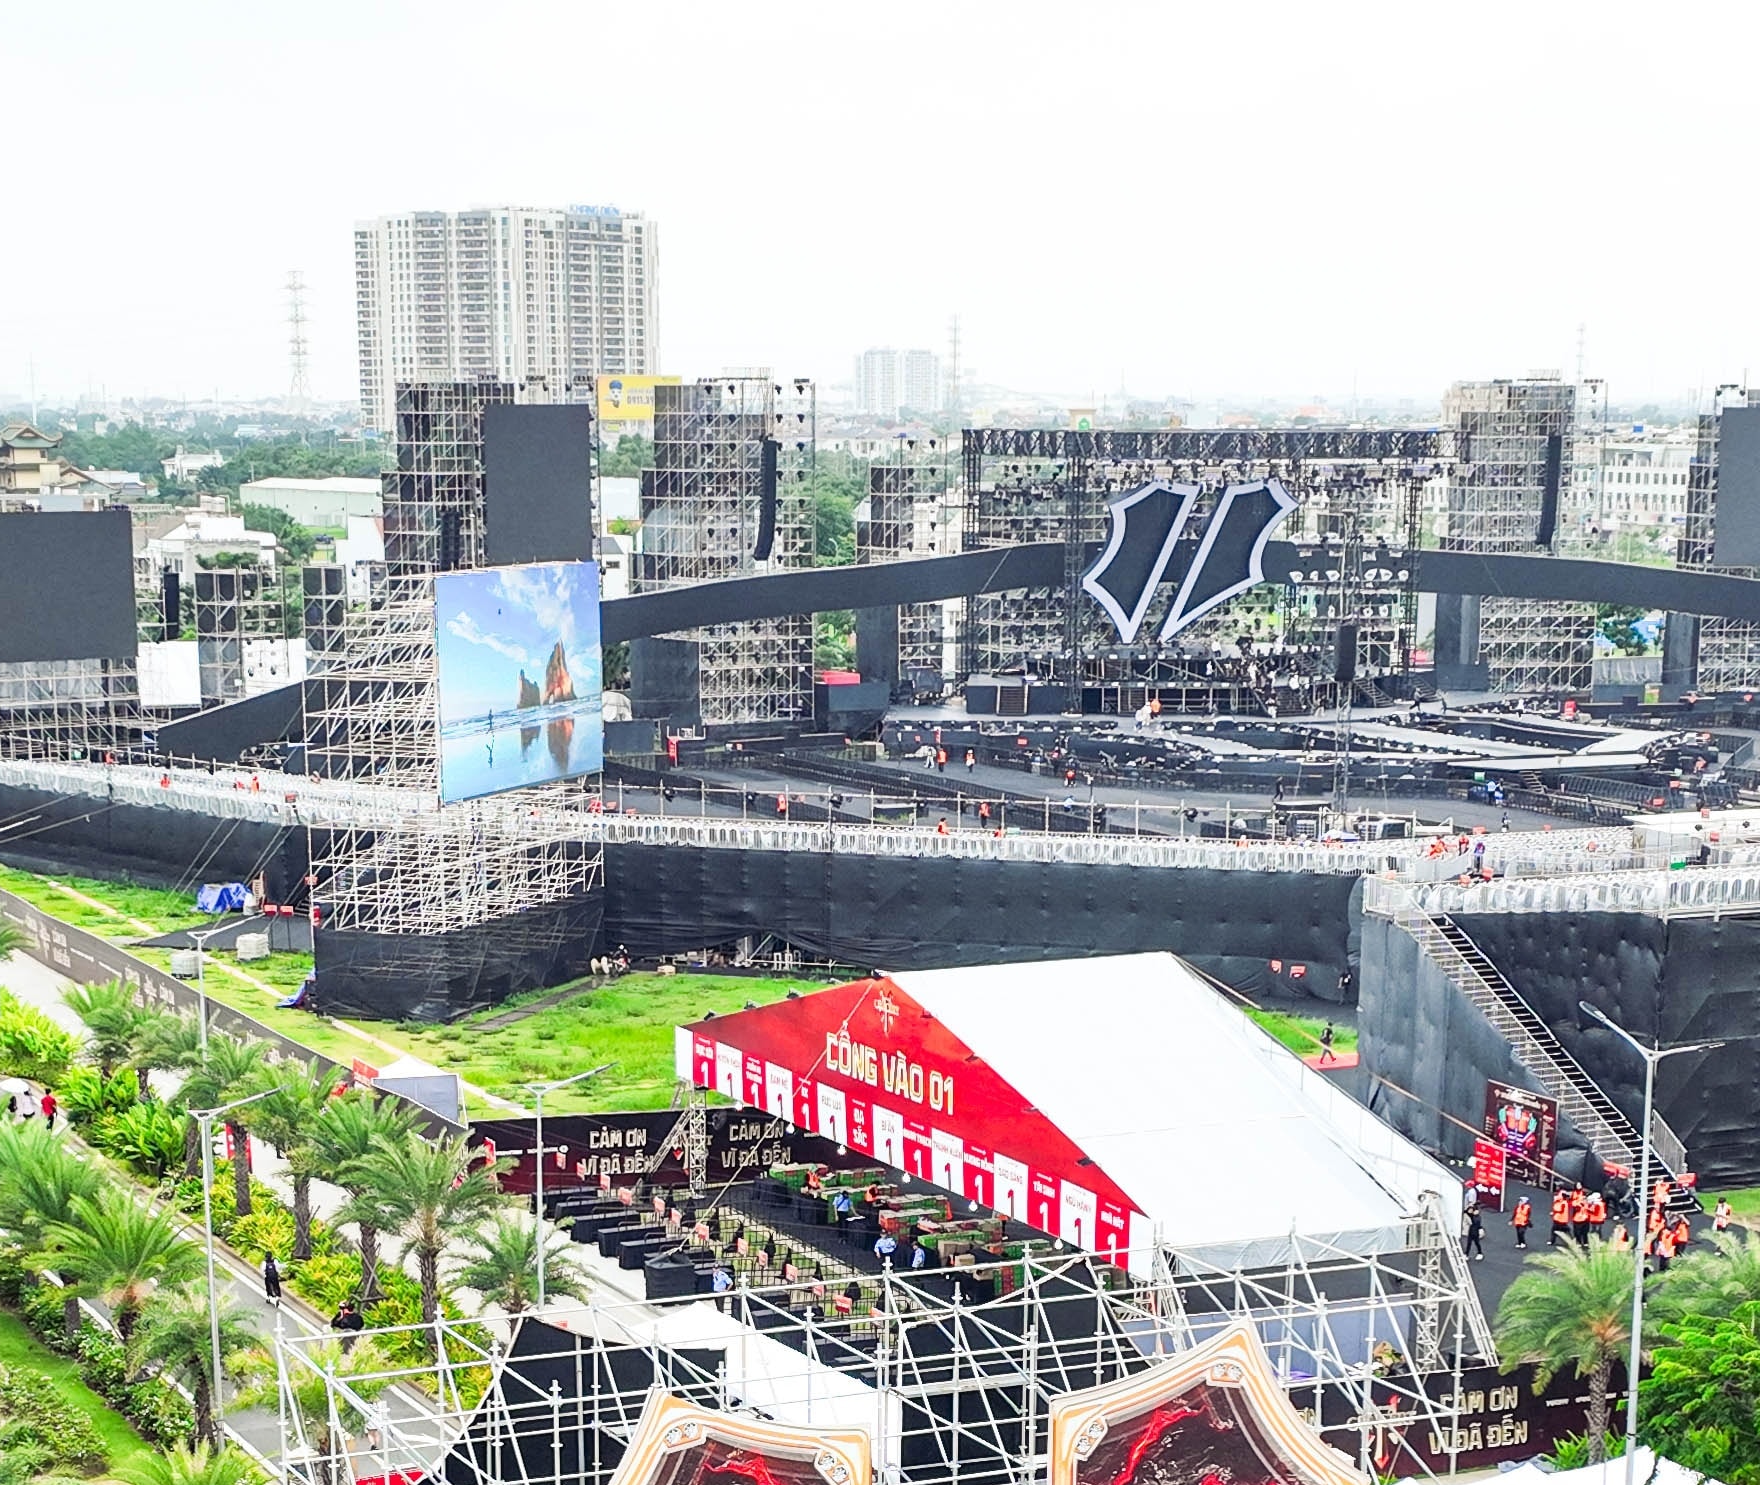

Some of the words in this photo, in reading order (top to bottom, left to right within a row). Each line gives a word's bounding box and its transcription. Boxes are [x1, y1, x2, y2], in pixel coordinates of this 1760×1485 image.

[882, 1050, 924, 1104] VÀO
[929, 1070, 954, 1116] 01
[590, 1126, 622, 1149] CẢM
[625, 1127, 647, 1147] ƠN
[729, 1119, 760, 1141] CẢM
[600, 1154, 621, 1175] ĐÃ
[721, 1147, 737, 1168] VÌ
[1490, 1385, 1518, 1413] ƠN
[1486, 1413, 1528, 1448] ĐẾN
